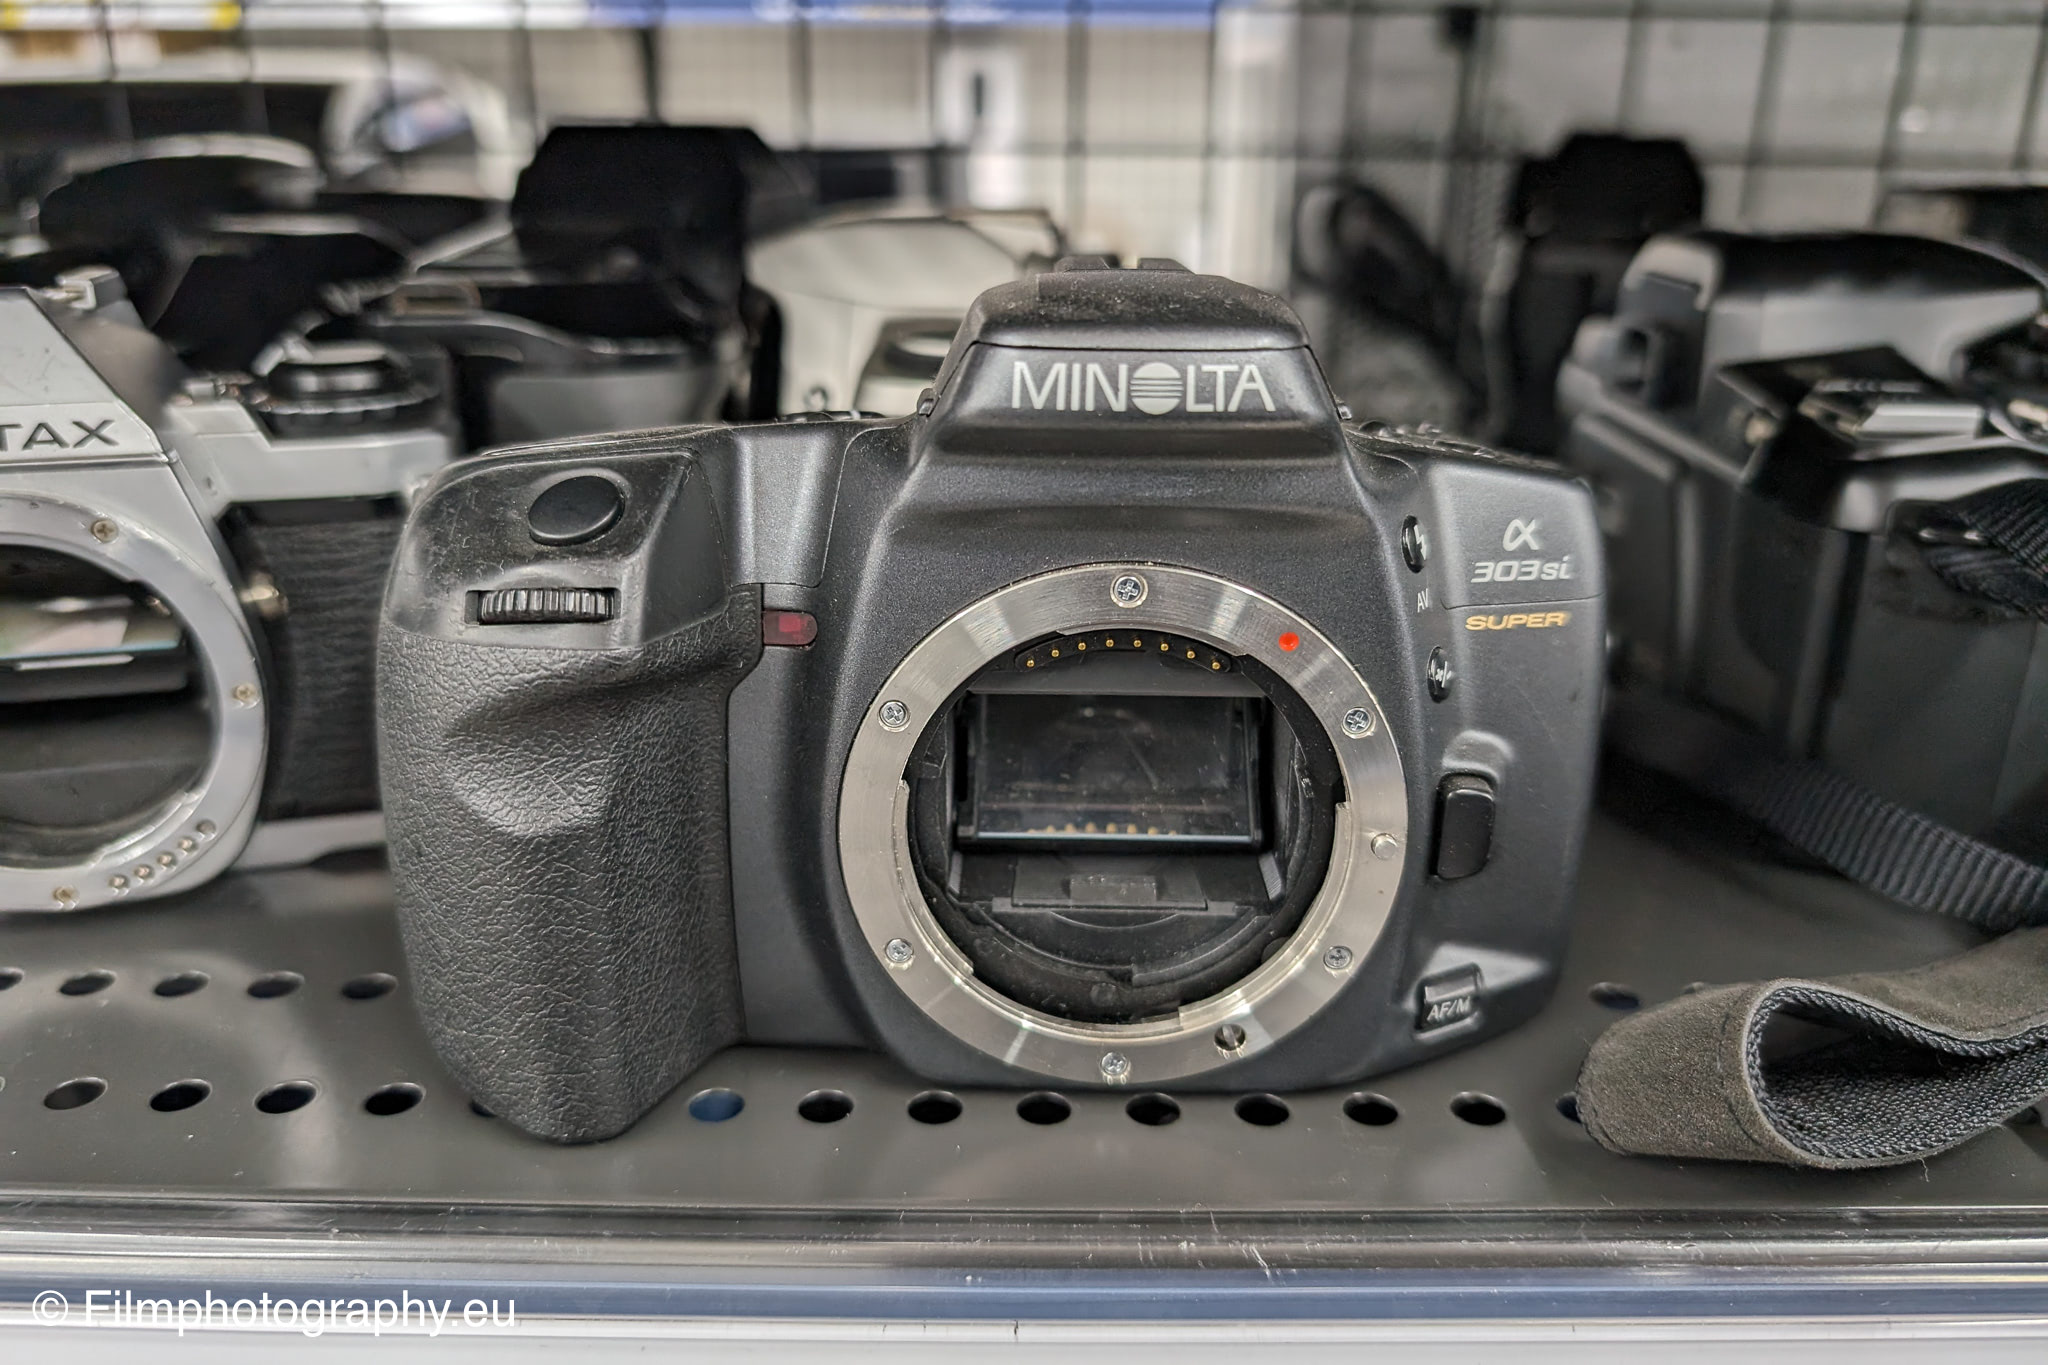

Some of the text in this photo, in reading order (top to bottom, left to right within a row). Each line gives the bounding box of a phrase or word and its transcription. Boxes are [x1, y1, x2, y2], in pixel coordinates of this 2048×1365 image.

[1011, 361, 1276, 415] MINOLTA
[1470, 555, 1572, 583] 303si
[1417, 588, 1429, 612] AV
[1465, 612, 1570, 631] SUPER
[1426, 995, 1471, 1022] AF/M
